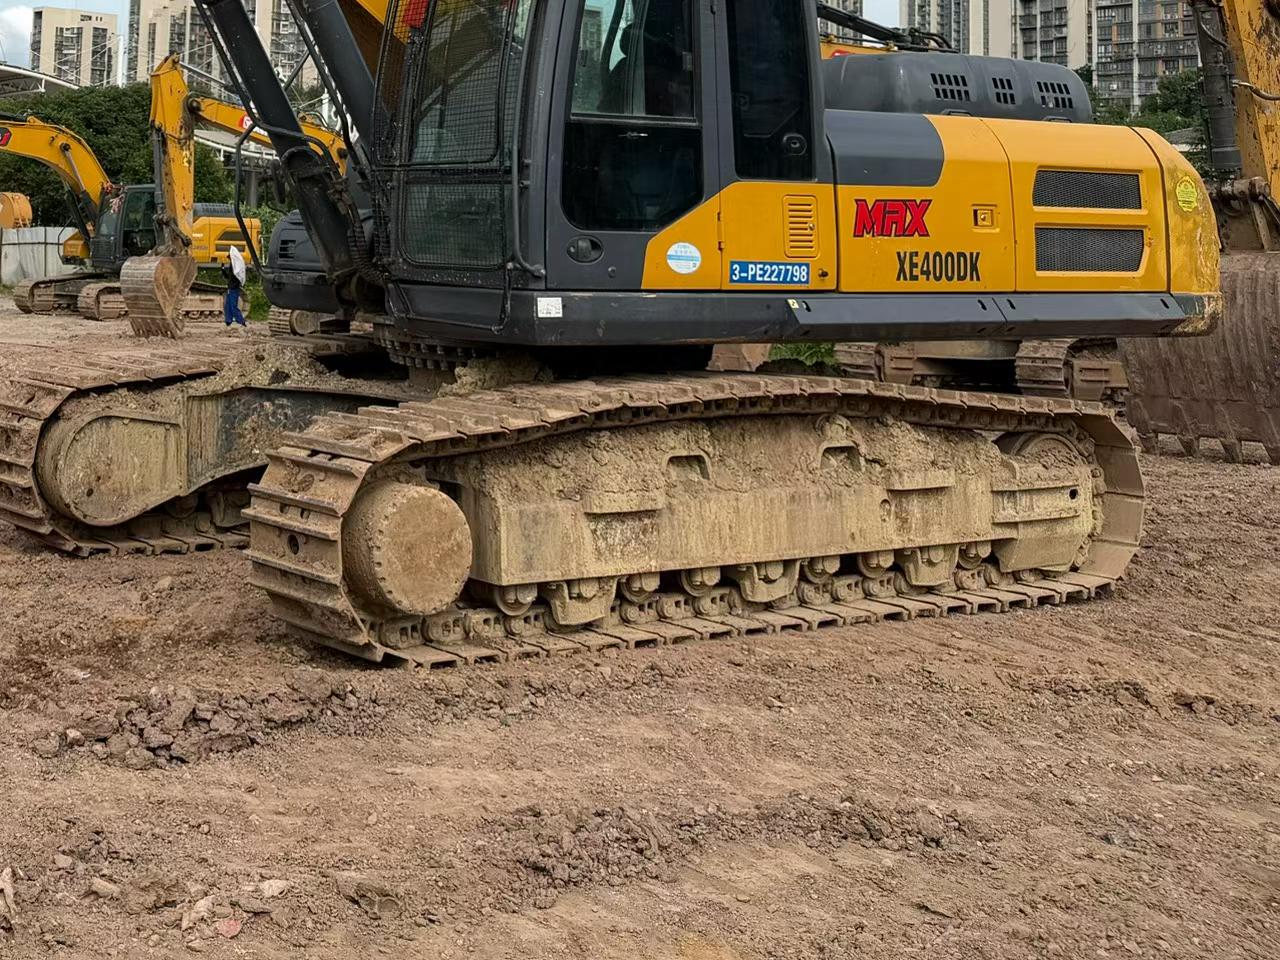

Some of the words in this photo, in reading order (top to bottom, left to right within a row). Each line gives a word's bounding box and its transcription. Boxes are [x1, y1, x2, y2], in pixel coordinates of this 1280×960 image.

[853, 199, 933, 238] MAX
[731, 263, 809, 283] 3-PE227798
[896, 251, 981, 282] XE400DK
